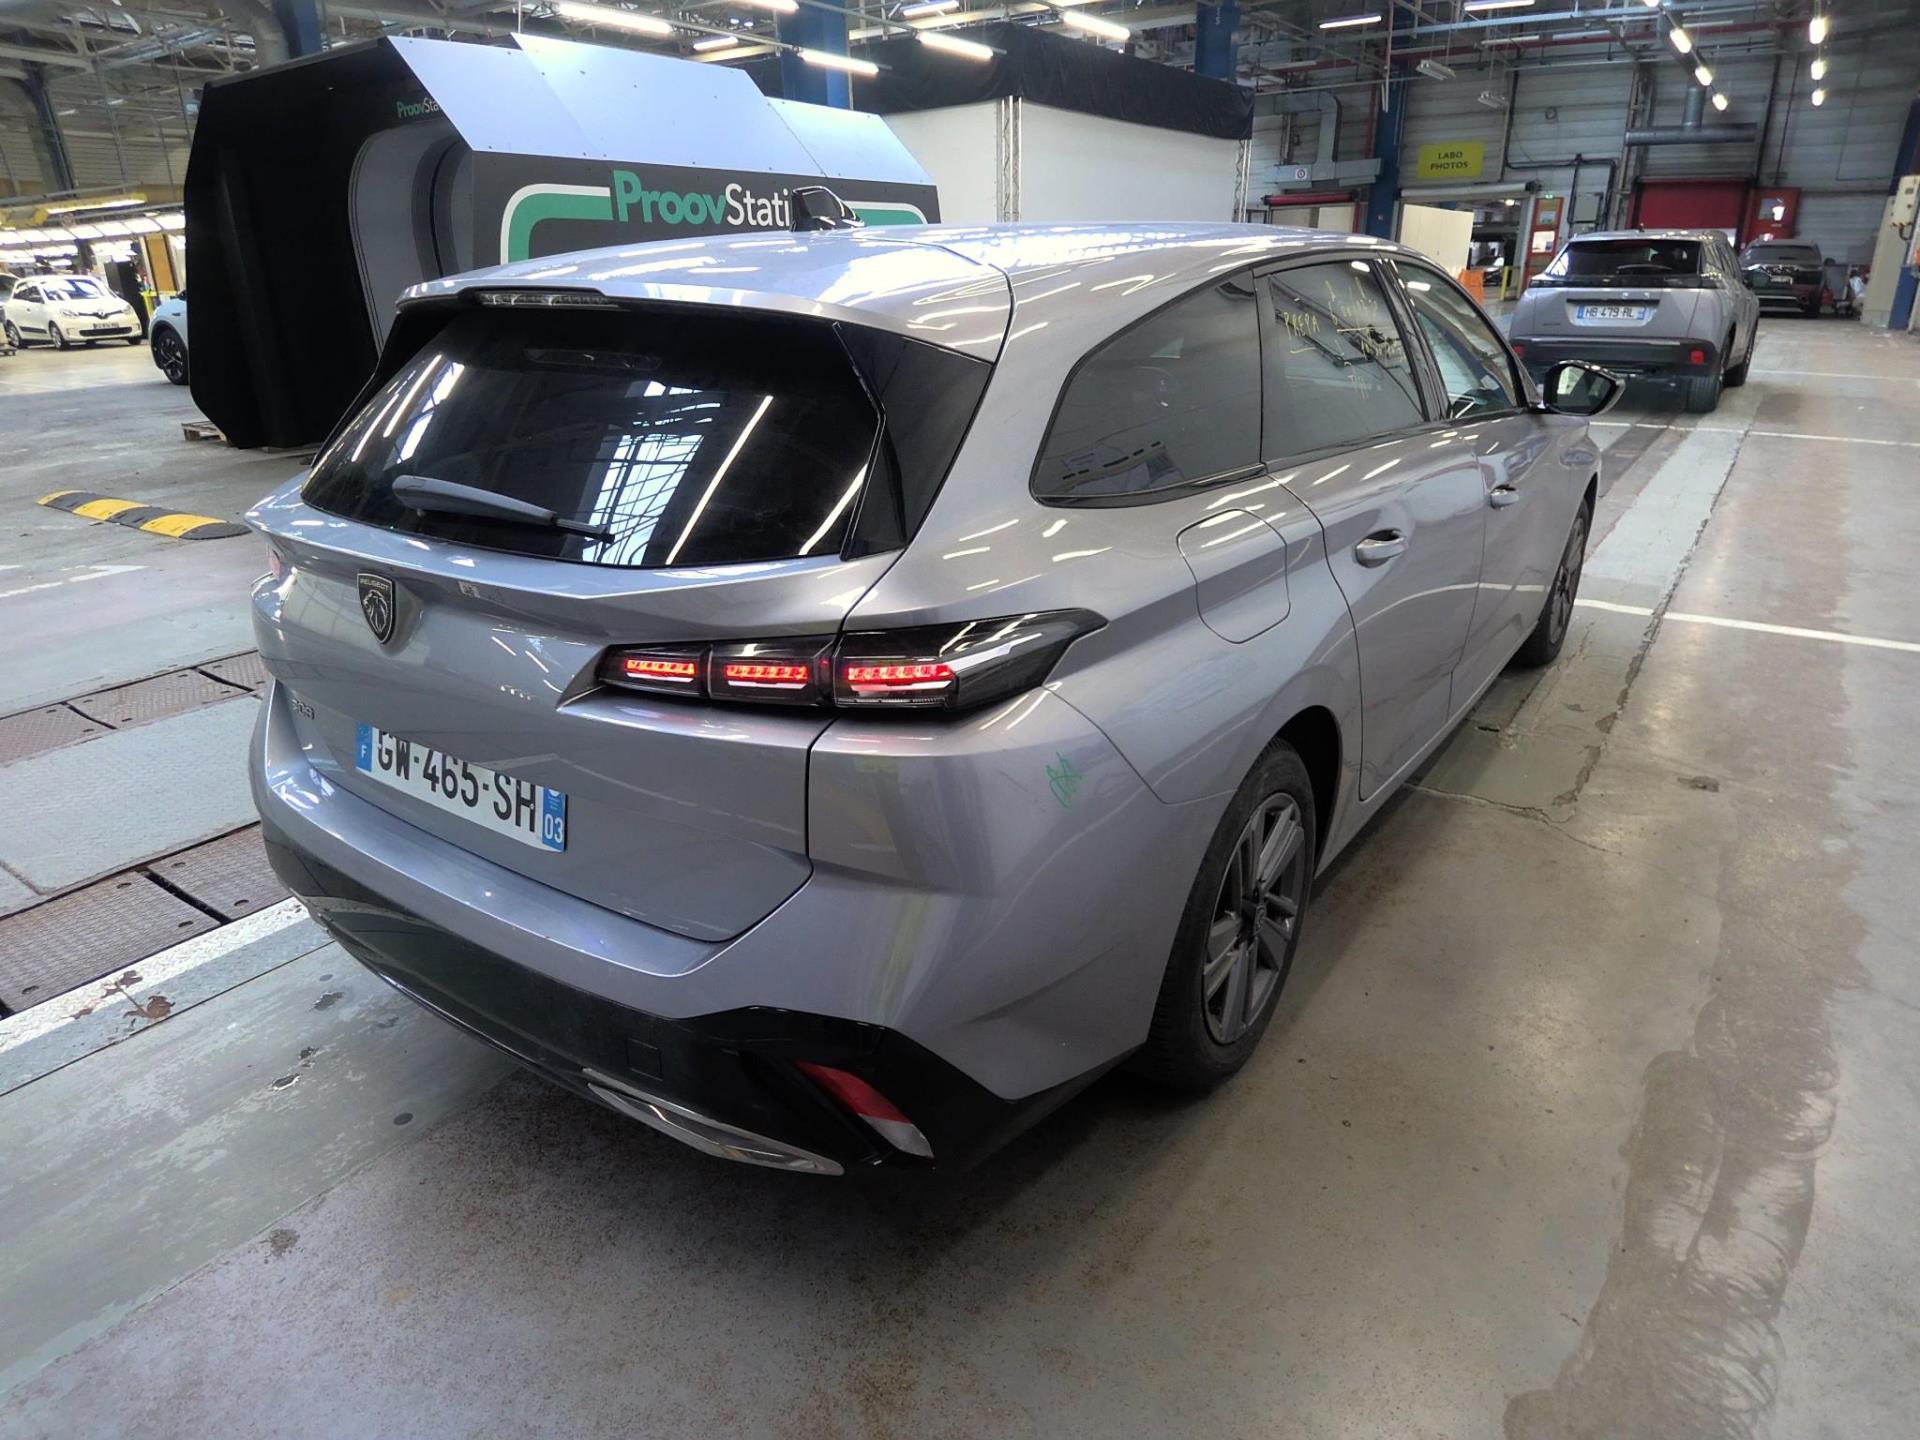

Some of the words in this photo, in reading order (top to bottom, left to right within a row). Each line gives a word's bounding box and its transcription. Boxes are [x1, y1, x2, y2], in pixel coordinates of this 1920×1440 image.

[397, 97, 439, 118] ProovSta
[1430, 160, 1469, 170] PHOTOS
[1438, 151, 1463, 160] LABO
[613, 169, 790, 227] ProovStati
[544, 813, 564, 843] 03
